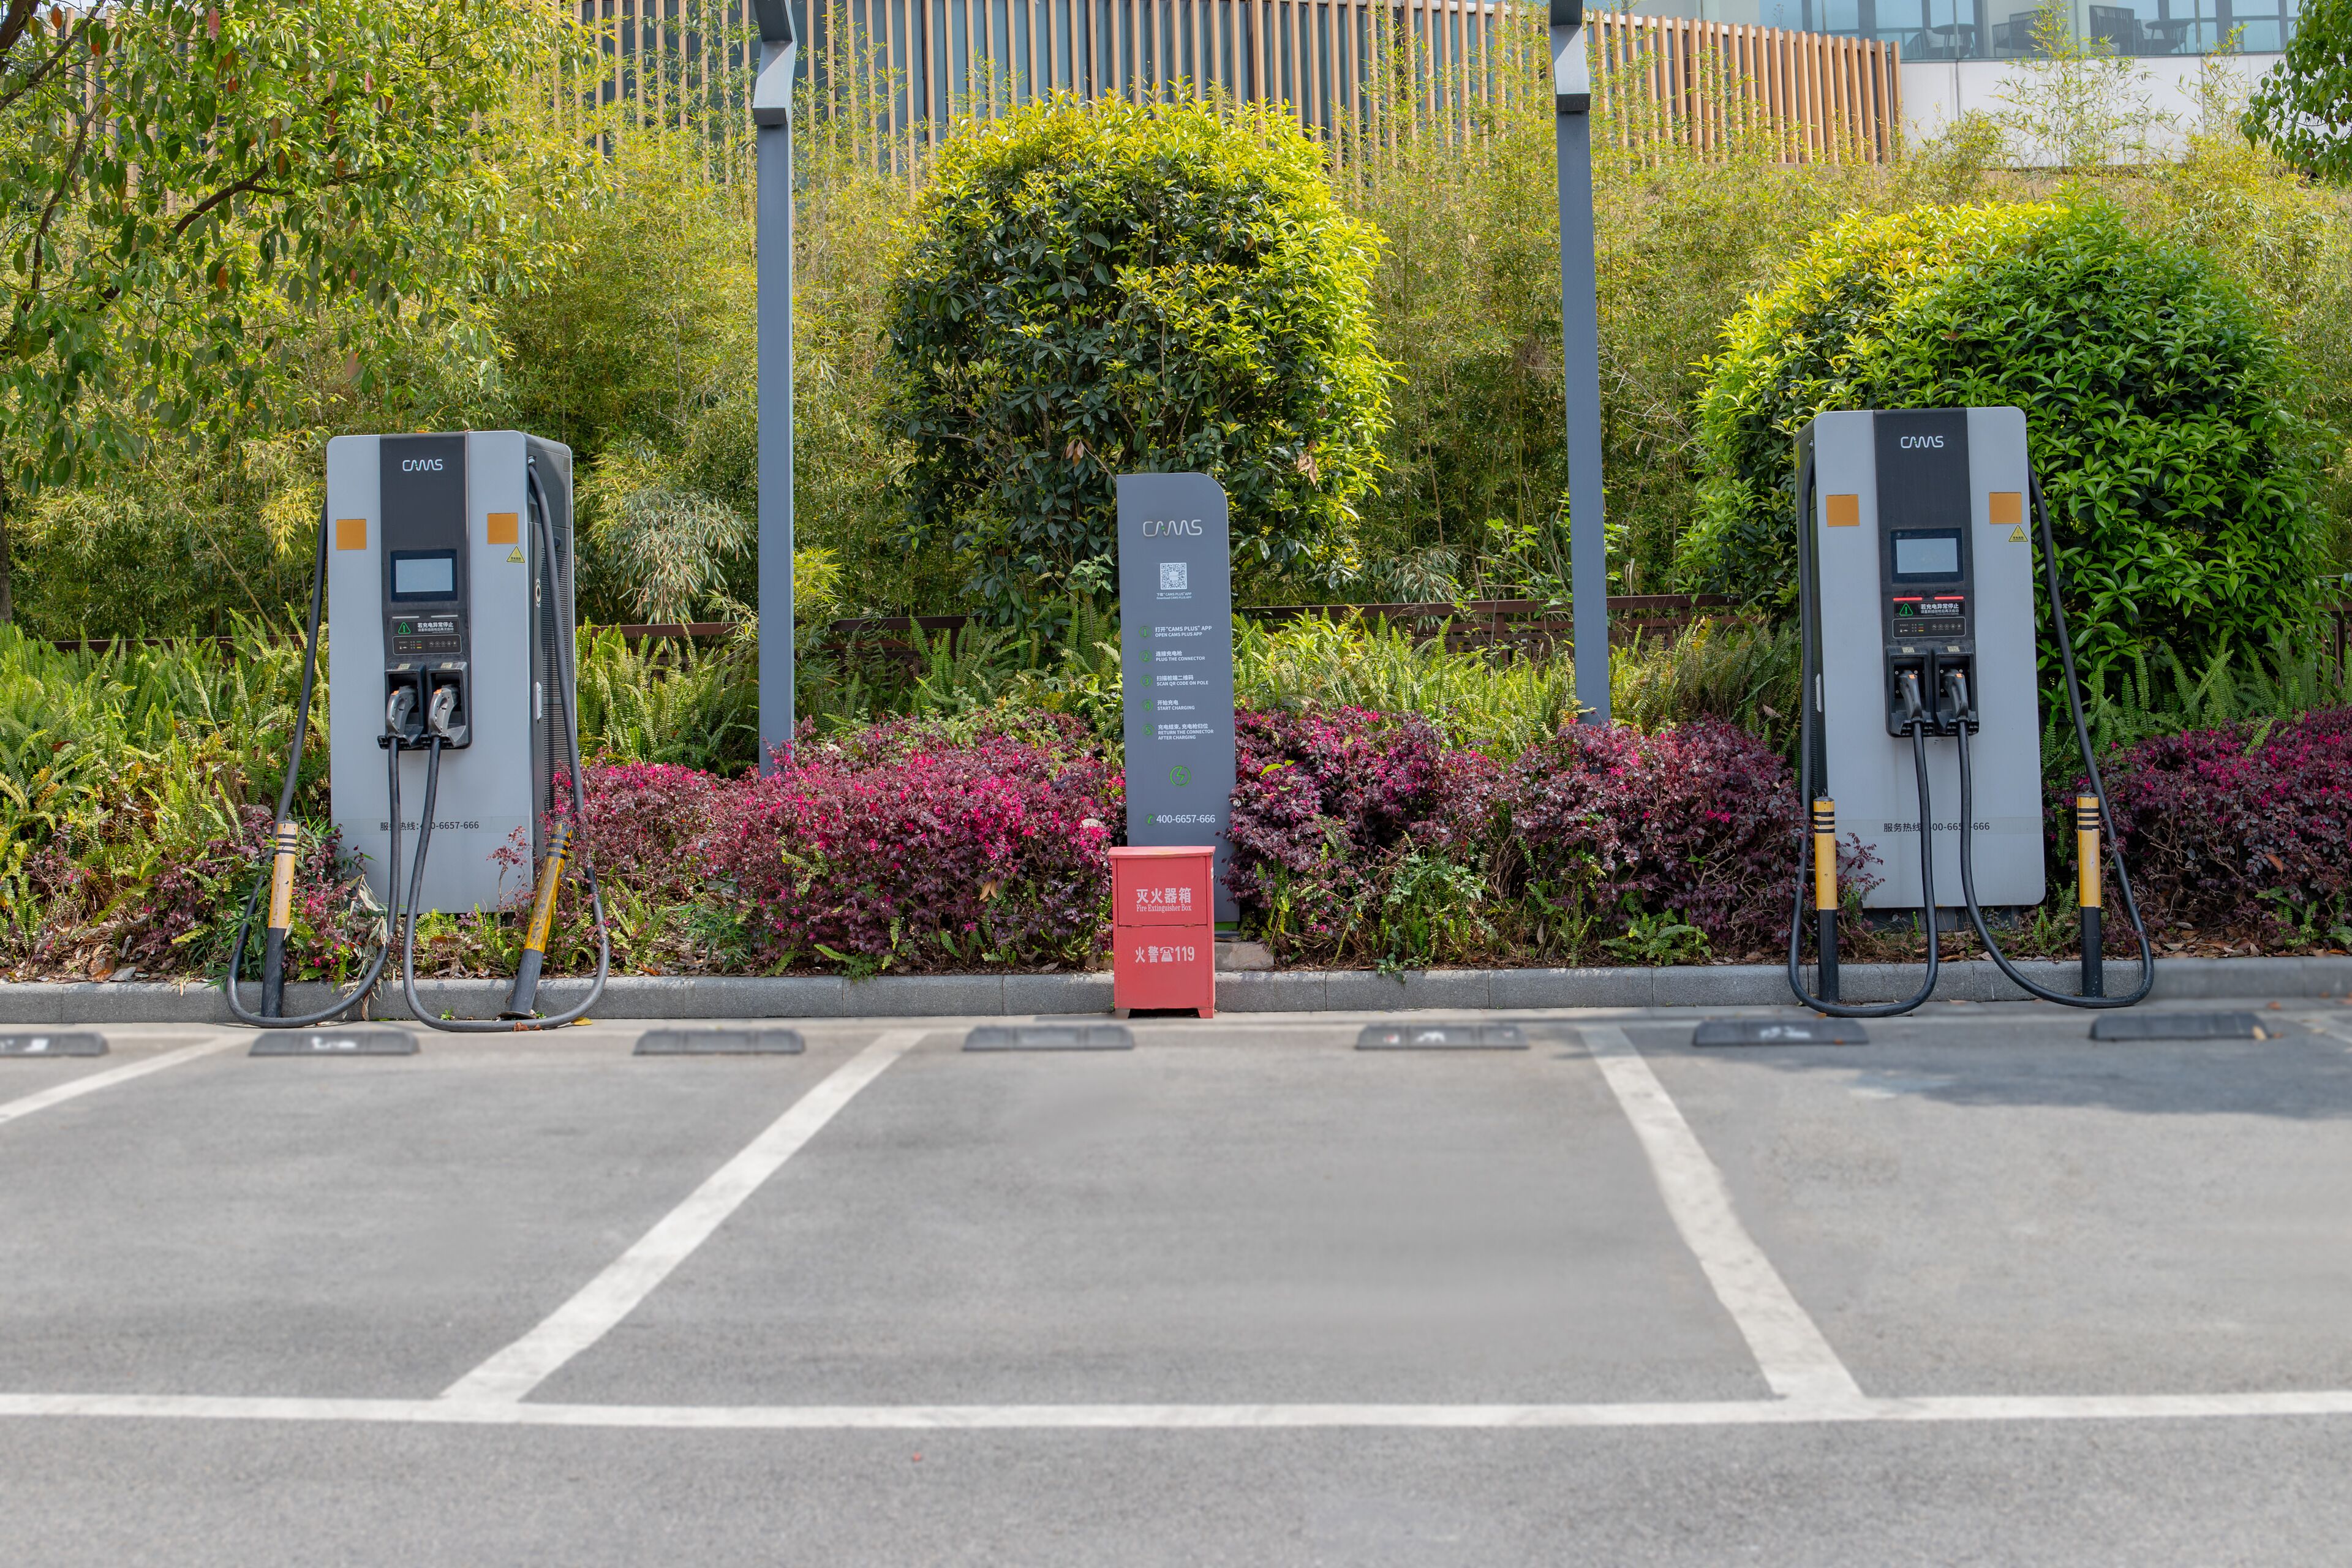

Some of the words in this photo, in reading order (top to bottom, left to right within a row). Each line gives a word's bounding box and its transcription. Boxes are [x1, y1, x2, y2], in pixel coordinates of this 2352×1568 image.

[1156, 814, 1215, 823] 400-6657-666
[1136, 887, 1191, 904] 灭火器箱
[1148, 903, 1181, 913] Extinguisher
[1135, 946, 1159, 963] 火警
[1175, 946, 1195, 962] 119
